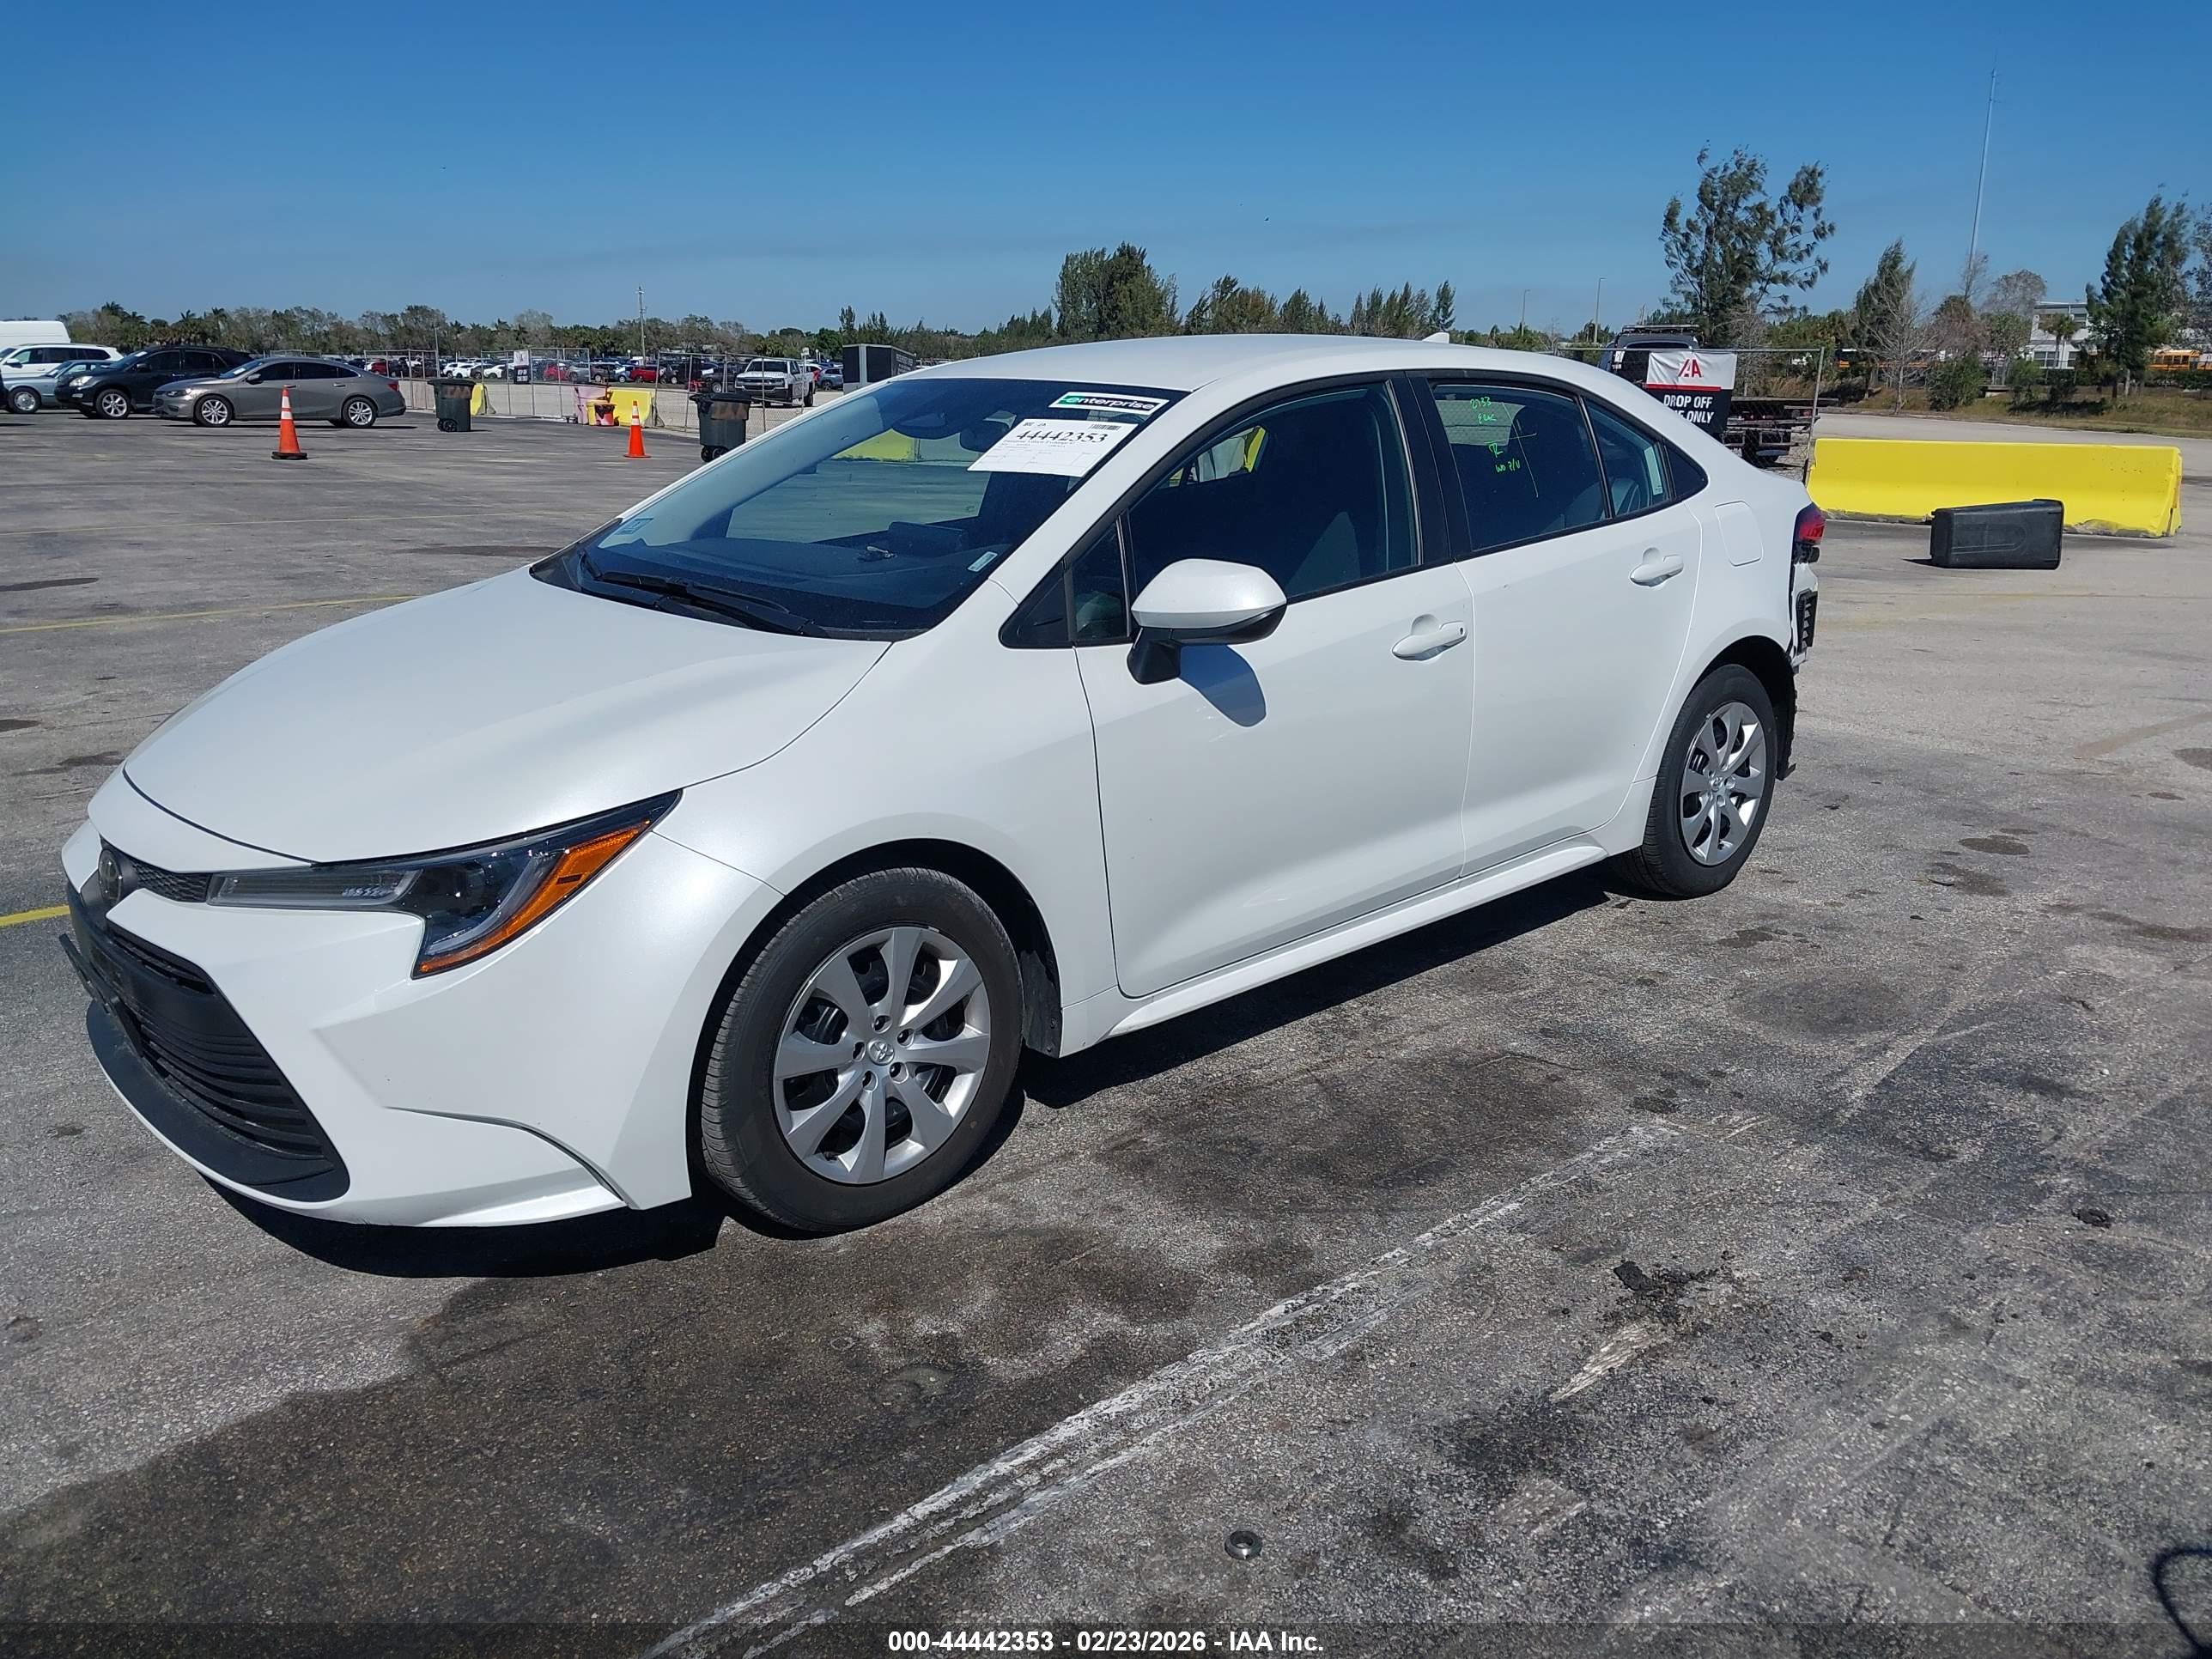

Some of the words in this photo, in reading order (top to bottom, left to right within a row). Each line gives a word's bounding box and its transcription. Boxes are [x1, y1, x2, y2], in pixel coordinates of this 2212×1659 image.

[1065, 397, 1155, 410] enterprise
[1663, 394, 1692, 408] DROP
[1693, 396, 1713, 409] OFF
[1686, 410, 1715, 424] ONLY
[1016, 430, 1109, 443] 44442353
